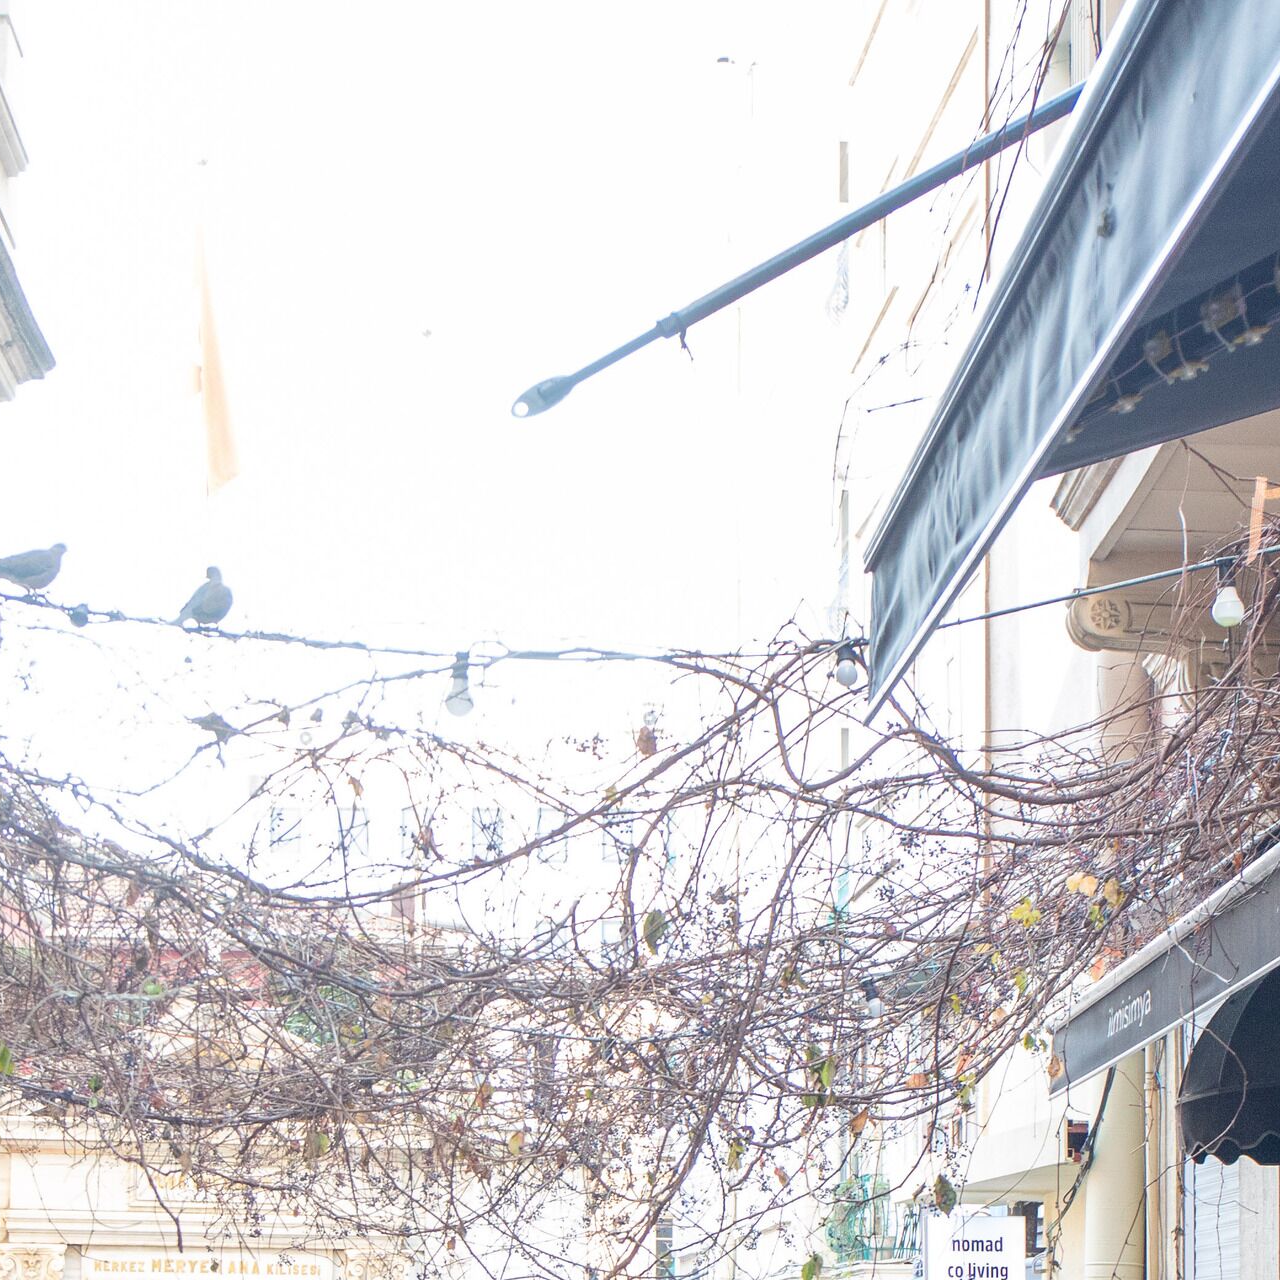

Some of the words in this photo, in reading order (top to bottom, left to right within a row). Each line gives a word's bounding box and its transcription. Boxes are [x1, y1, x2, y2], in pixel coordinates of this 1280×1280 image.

[952, 1236, 1003, 1252] nomad
[94, 1260, 145, 1273] MERKEZ
[228, 1261, 260, 1275] ANA
[948, 1266, 963, 1278] co
[968, 1262, 1009, 1280] living
